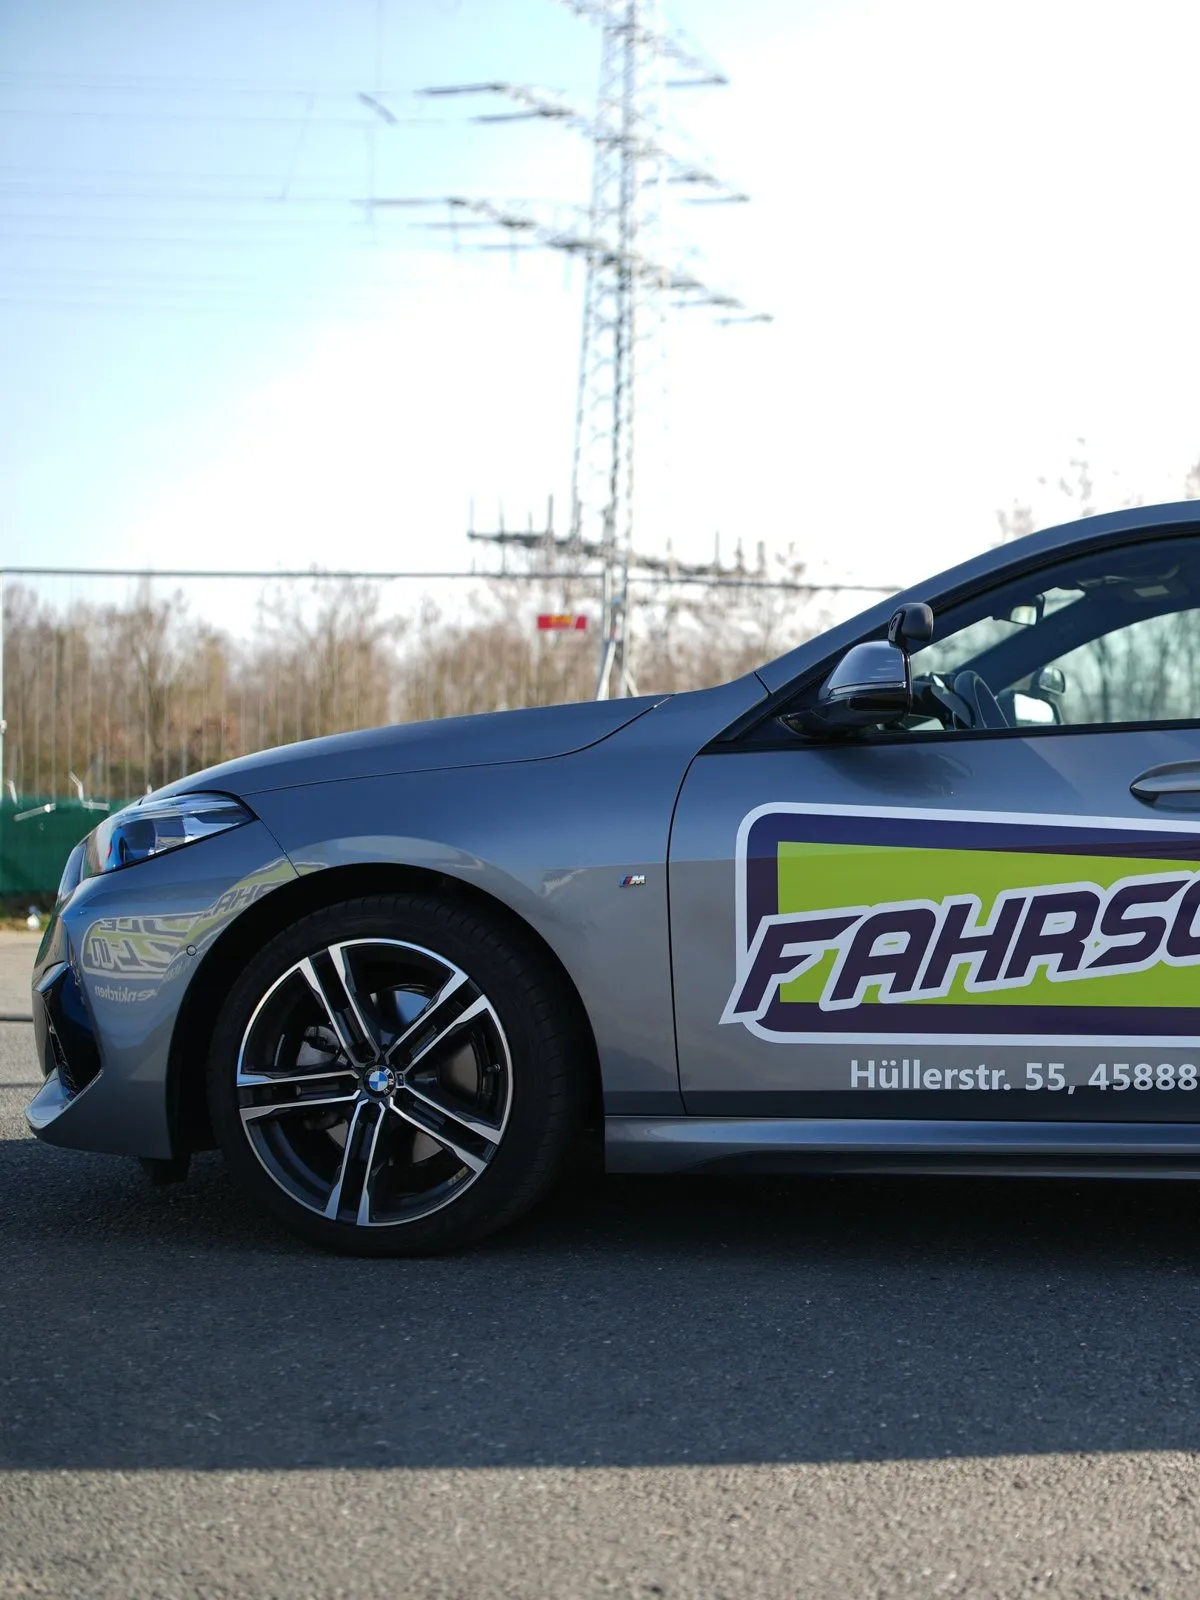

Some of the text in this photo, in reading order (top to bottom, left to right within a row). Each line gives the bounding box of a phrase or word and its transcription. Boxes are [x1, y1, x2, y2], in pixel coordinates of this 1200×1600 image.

[850, 1059, 1012, 1091] Hüllerstr.
[1025, 1062, 1076, 1095] 55,
[1088, 1063, 1198, 1092] 45888
